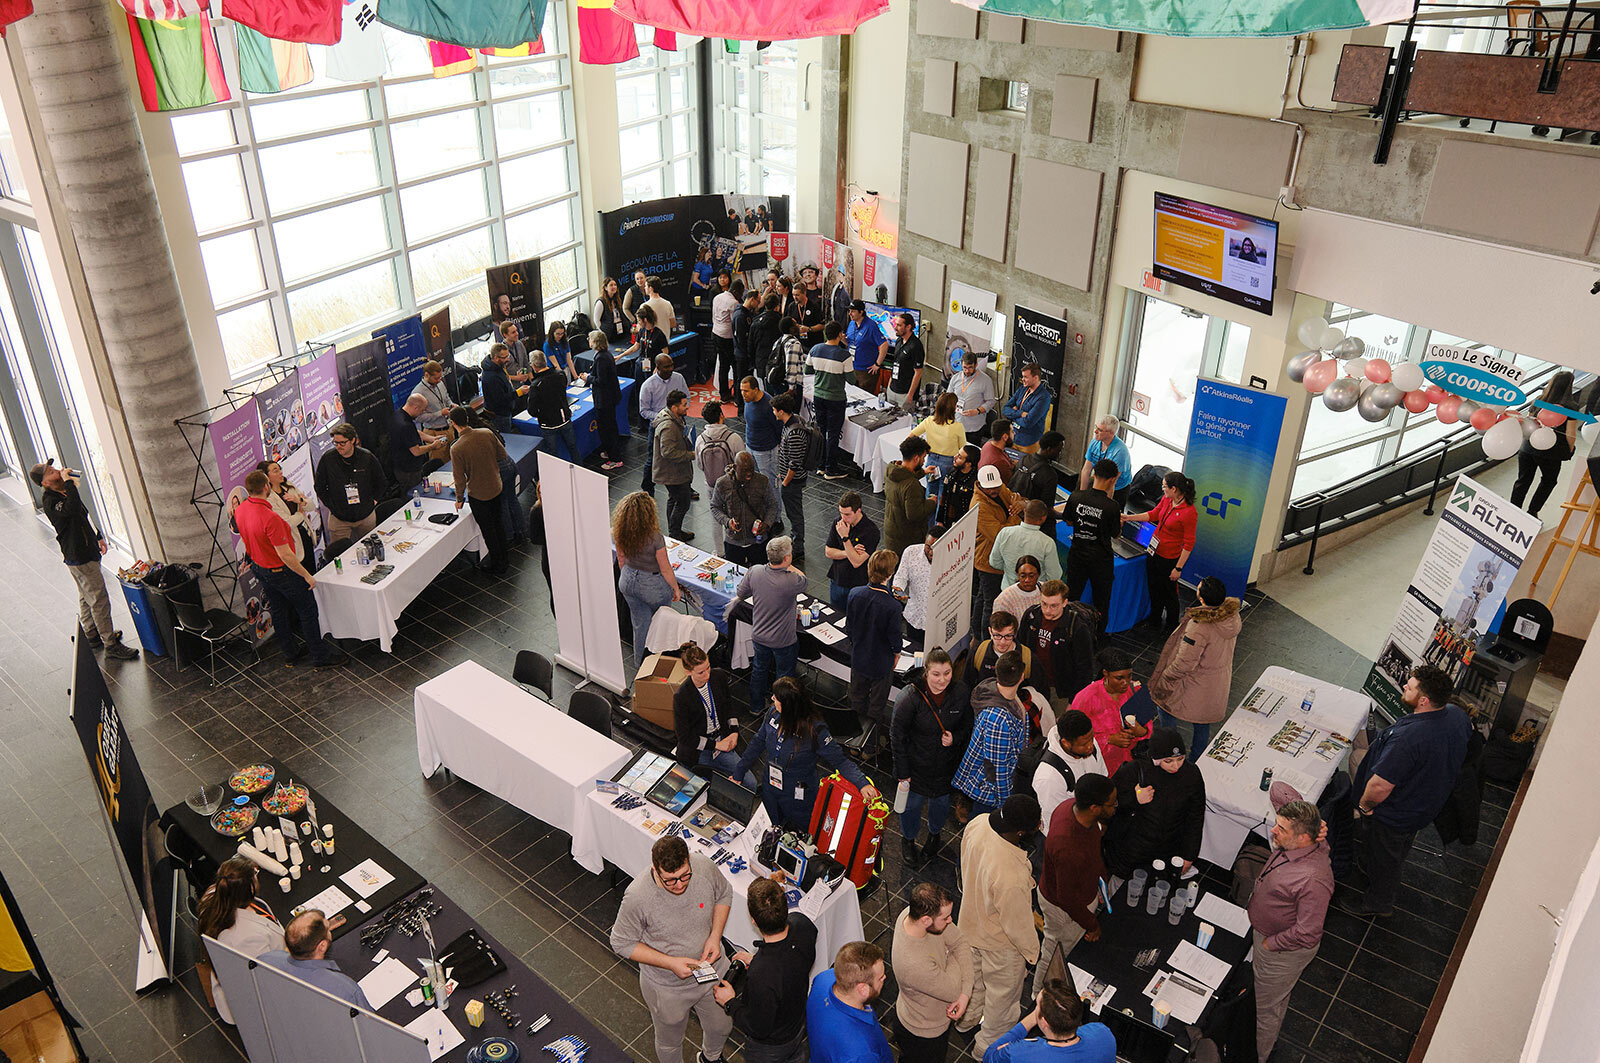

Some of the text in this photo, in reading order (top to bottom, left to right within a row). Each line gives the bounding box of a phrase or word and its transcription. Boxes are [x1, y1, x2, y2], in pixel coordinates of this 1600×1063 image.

[640, 213, 675, 225] TECHNOSUB
[666, 250, 678, 261] LA
[643, 261, 684, 276] GROUPE
[961, 304, 993, 326] WeldAlly
[1018, 317, 1061, 341] Radisson
[1431, 344, 1522, 382] Coop Le Signet
[1446, 370, 1517, 403] COOPSCO
[1211, 389, 1254, 405] AtkinsRéalis
[1198, 409, 1252, 431] Faire rayonner
[1205, 421, 1227, 433] génie
[1195, 427, 1222, 441] partout
[1478, 496, 1500, 512] GROUPE
[1471, 503, 1534, 550] ALTAN
